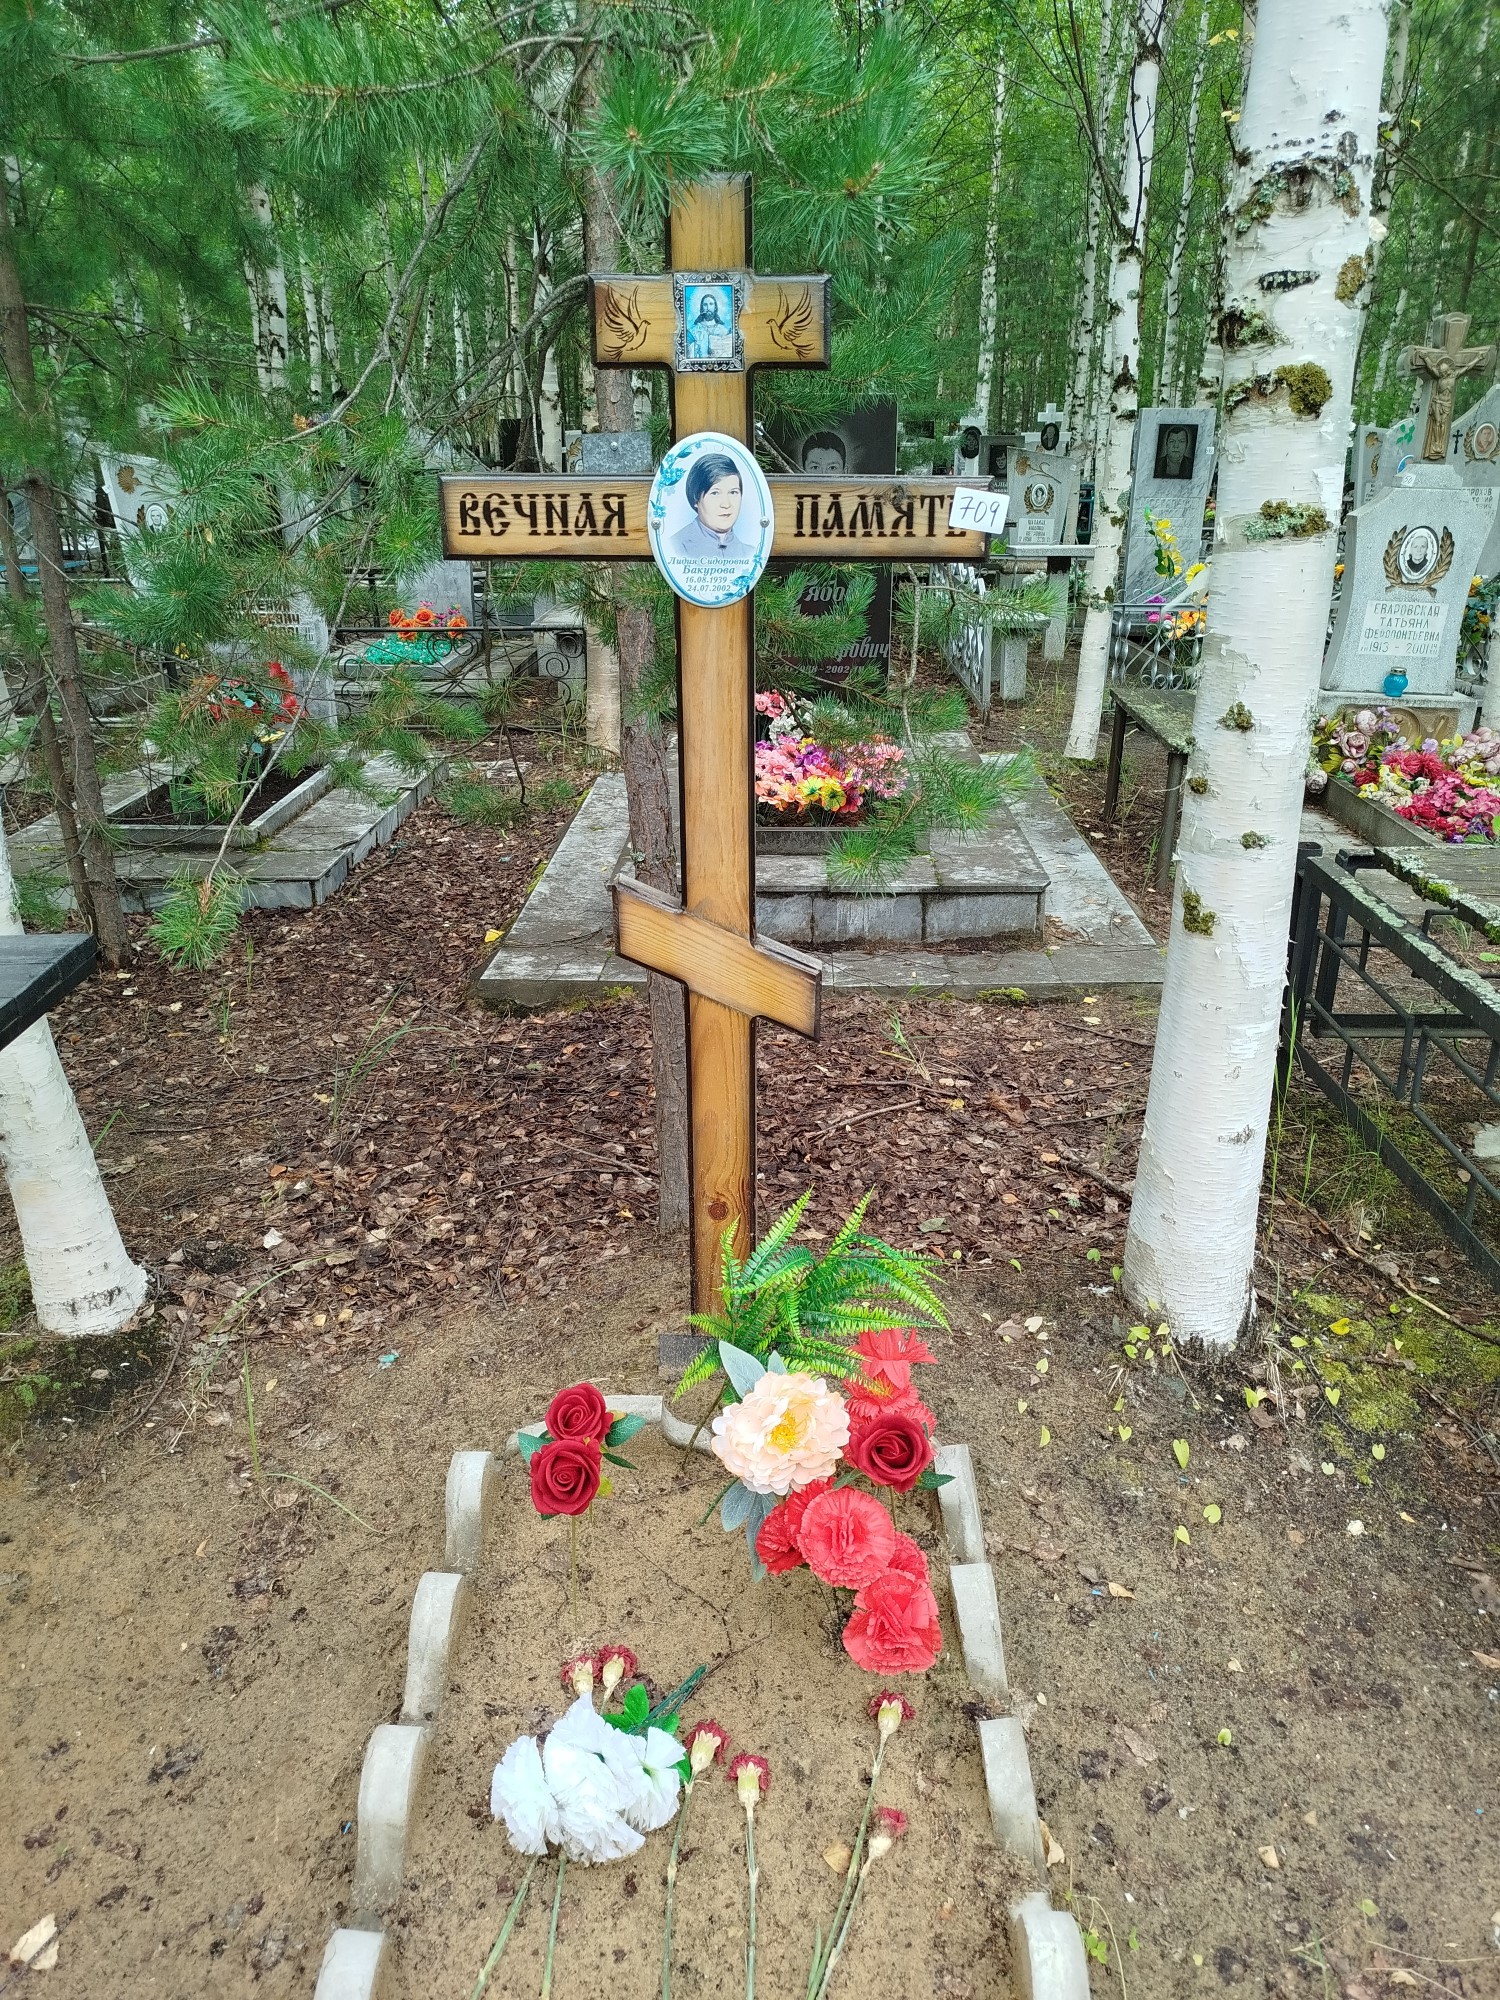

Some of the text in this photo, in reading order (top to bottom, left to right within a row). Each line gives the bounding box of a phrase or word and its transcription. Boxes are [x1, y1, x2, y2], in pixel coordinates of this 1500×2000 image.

[458, 492, 629, 537] ВЕЧНАЯ
[960, 496, 1000, 527] 709
[667, 557, 749, 566] Лидия Сидоровна
[682, 565, 735, 576] Бакурова
[685, 576, 728, 584] 16.08.1939
[1374, 603, 1440, 616] ЕВАРОВСКАЯ
[1380, 617, 1429, 629] ТАТЬЯНА
[825, 665, 850, 674] 2002
